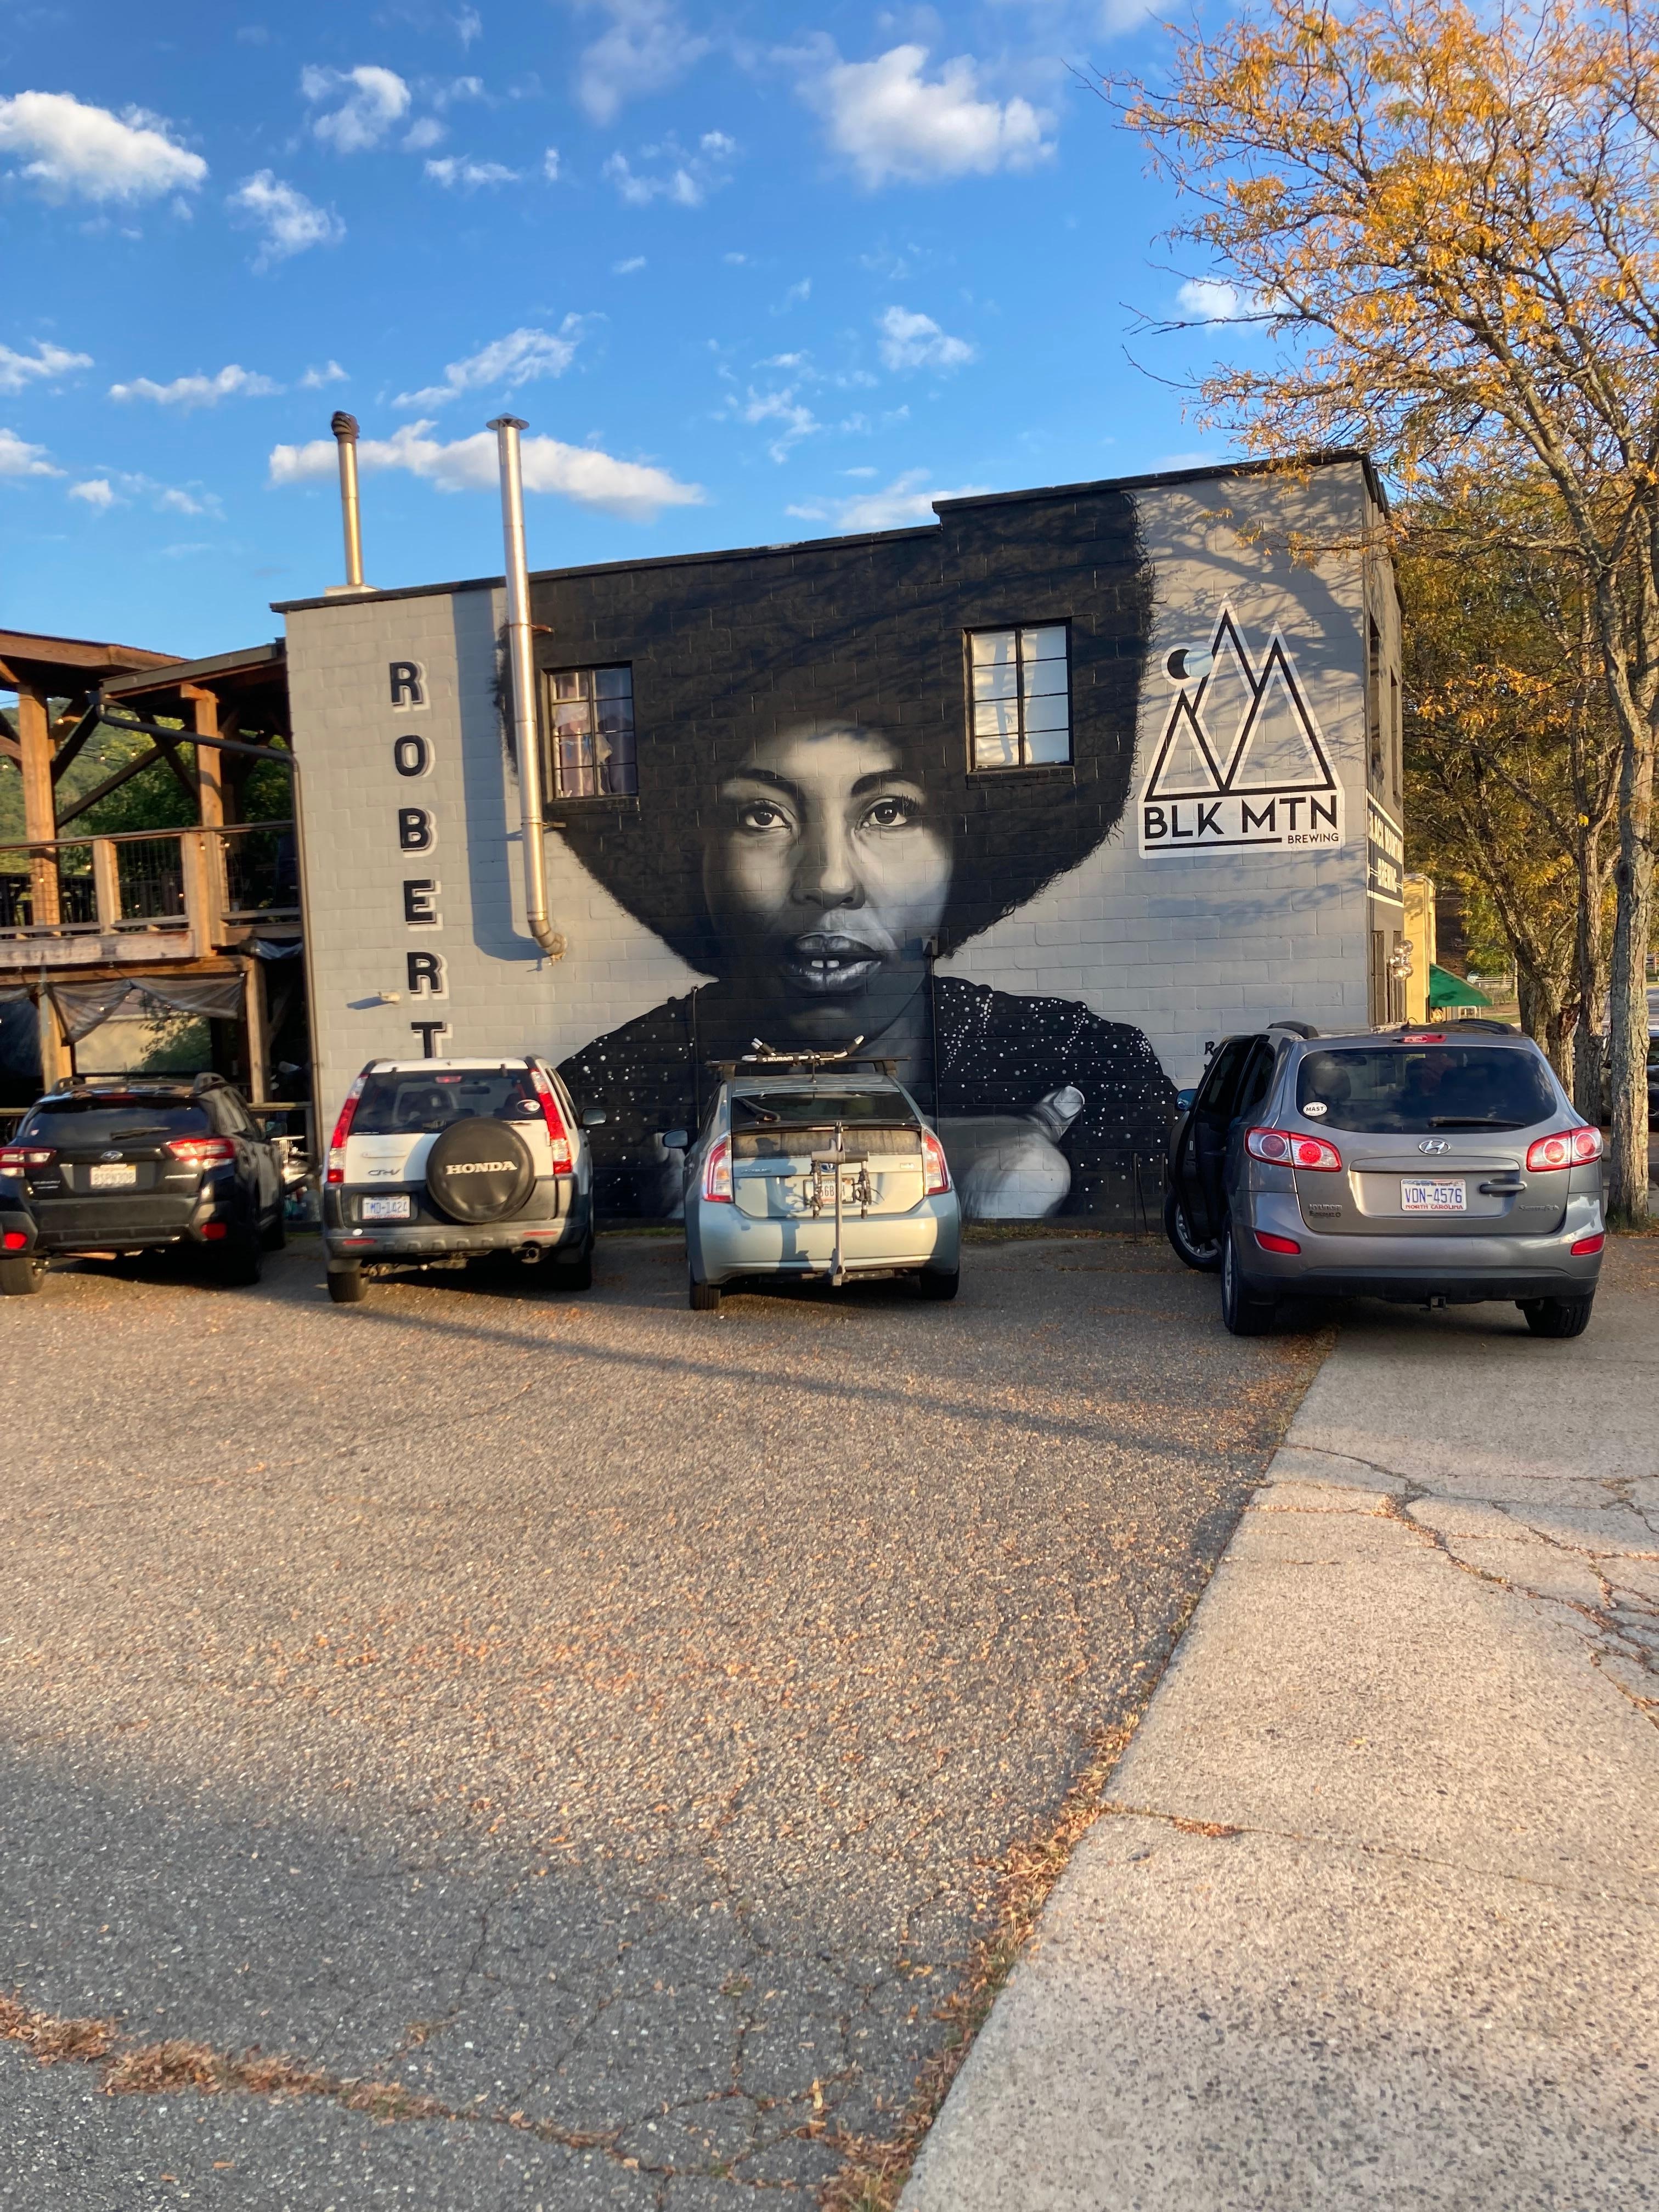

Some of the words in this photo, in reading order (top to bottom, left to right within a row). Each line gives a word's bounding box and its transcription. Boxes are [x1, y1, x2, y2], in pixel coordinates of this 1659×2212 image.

[1144, 802, 1224, 839] BLK
[1242, 795, 1337, 833] MTN
[1288, 833, 1339, 844] BREWING
[446, 1161, 517, 1175] HONDA
[1406, 1188, 1462, 1203] VDN-4576
